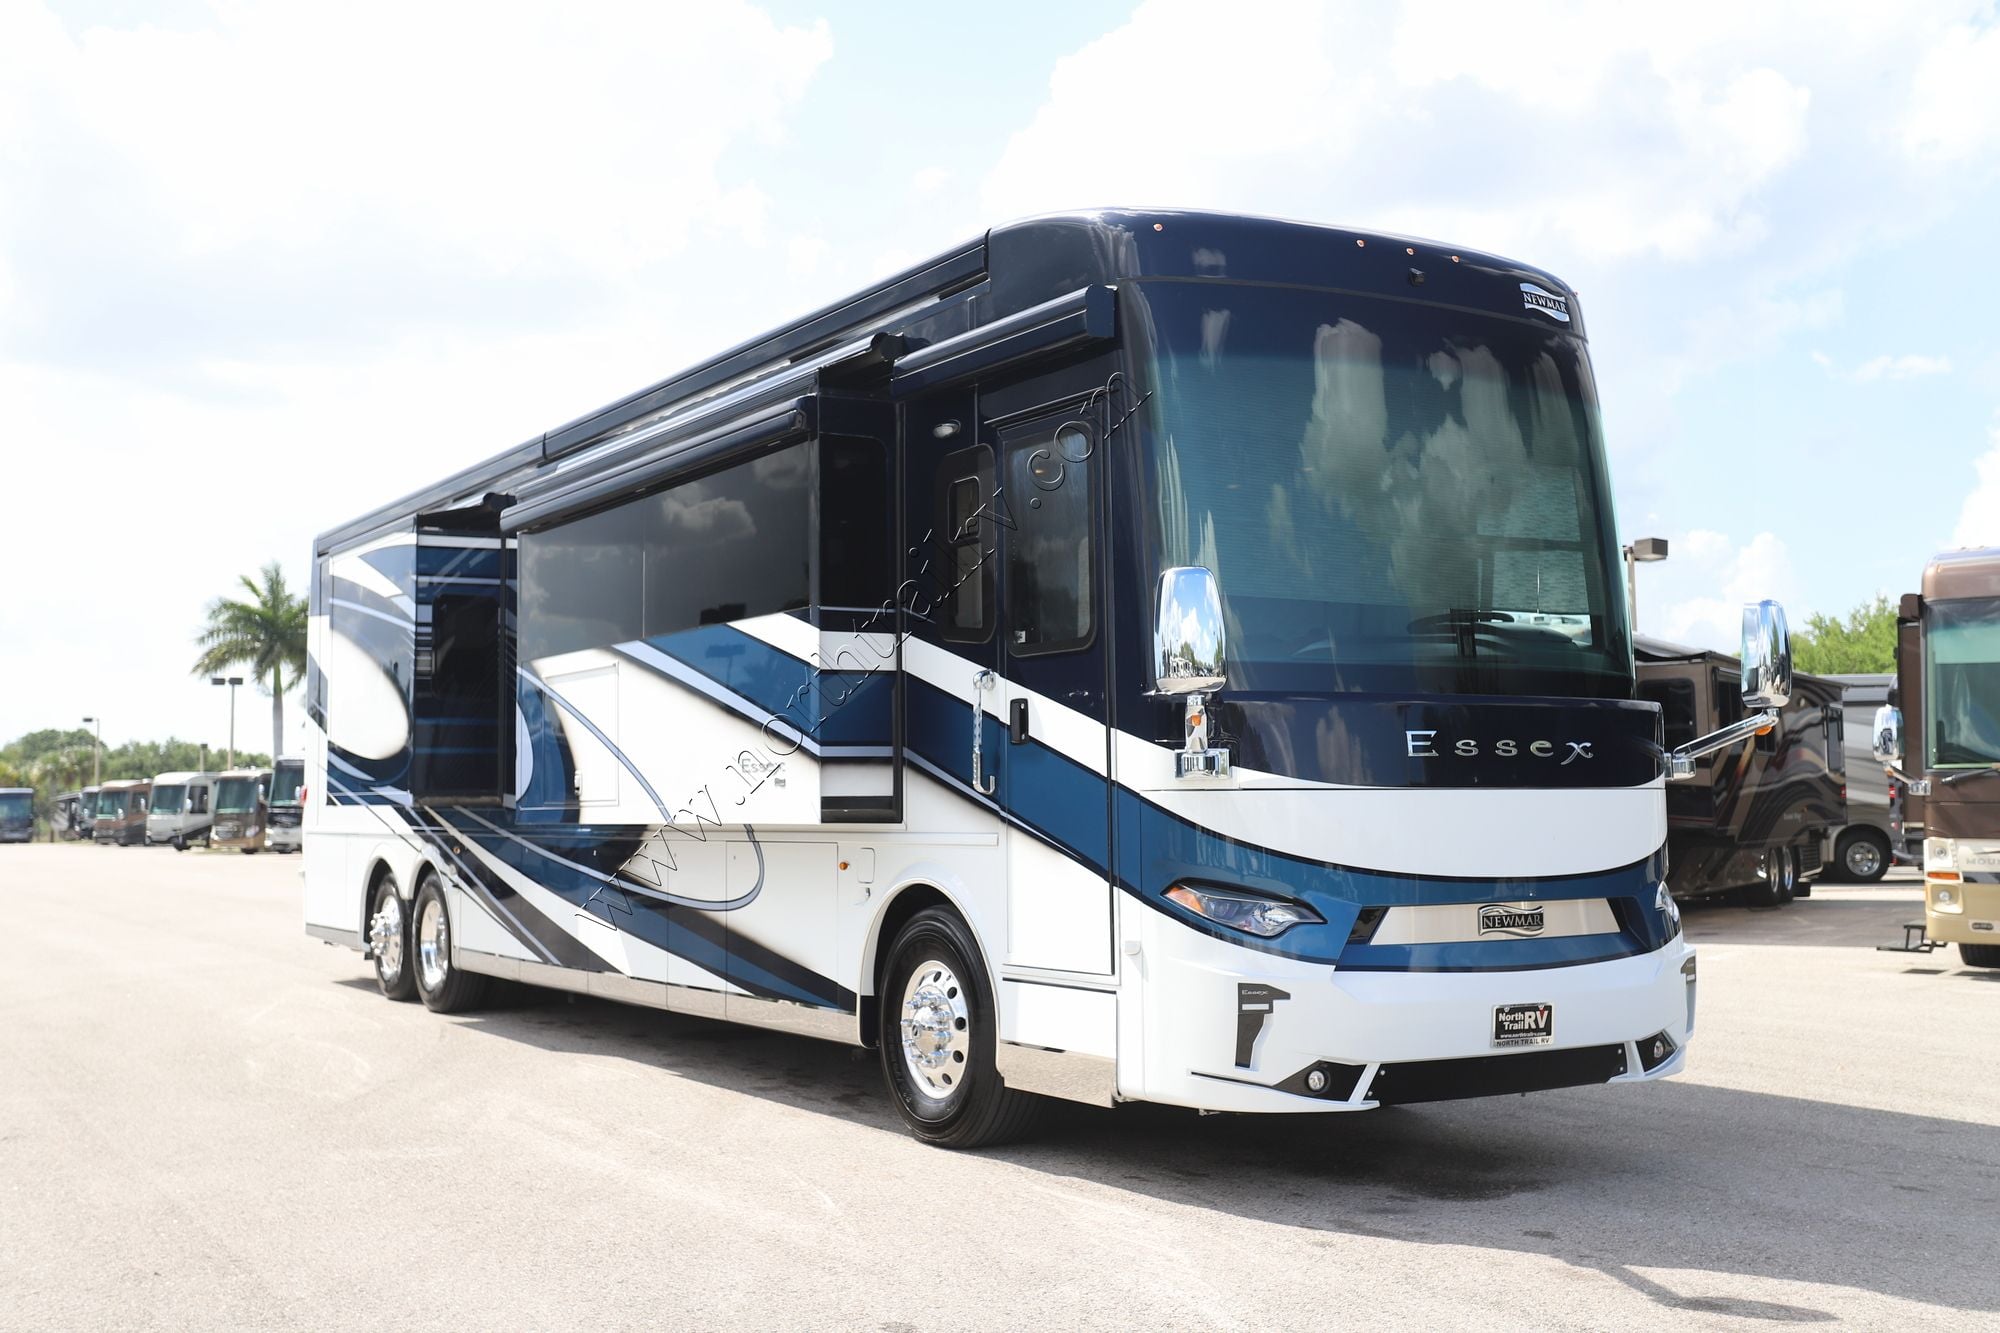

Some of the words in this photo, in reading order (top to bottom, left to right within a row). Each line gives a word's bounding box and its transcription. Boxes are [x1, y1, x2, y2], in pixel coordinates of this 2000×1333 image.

[1523, 292, 1567, 313] NEWMAR
[1405, 730, 1594, 765] Essex
[1966, 857, 2000, 865] MOU
[1483, 914, 1543, 928] NEWMAR
[1499, 1011, 1524, 1022] North
[1524, 1011, 1549, 1030] RV
[1503, 1021, 1524, 1031] Trail
[1496, 1039, 1519, 1047] NORTH
[1521, 1038, 1540, 1046] TRAIL
[1541, 1037, 1550, 1045] RV
